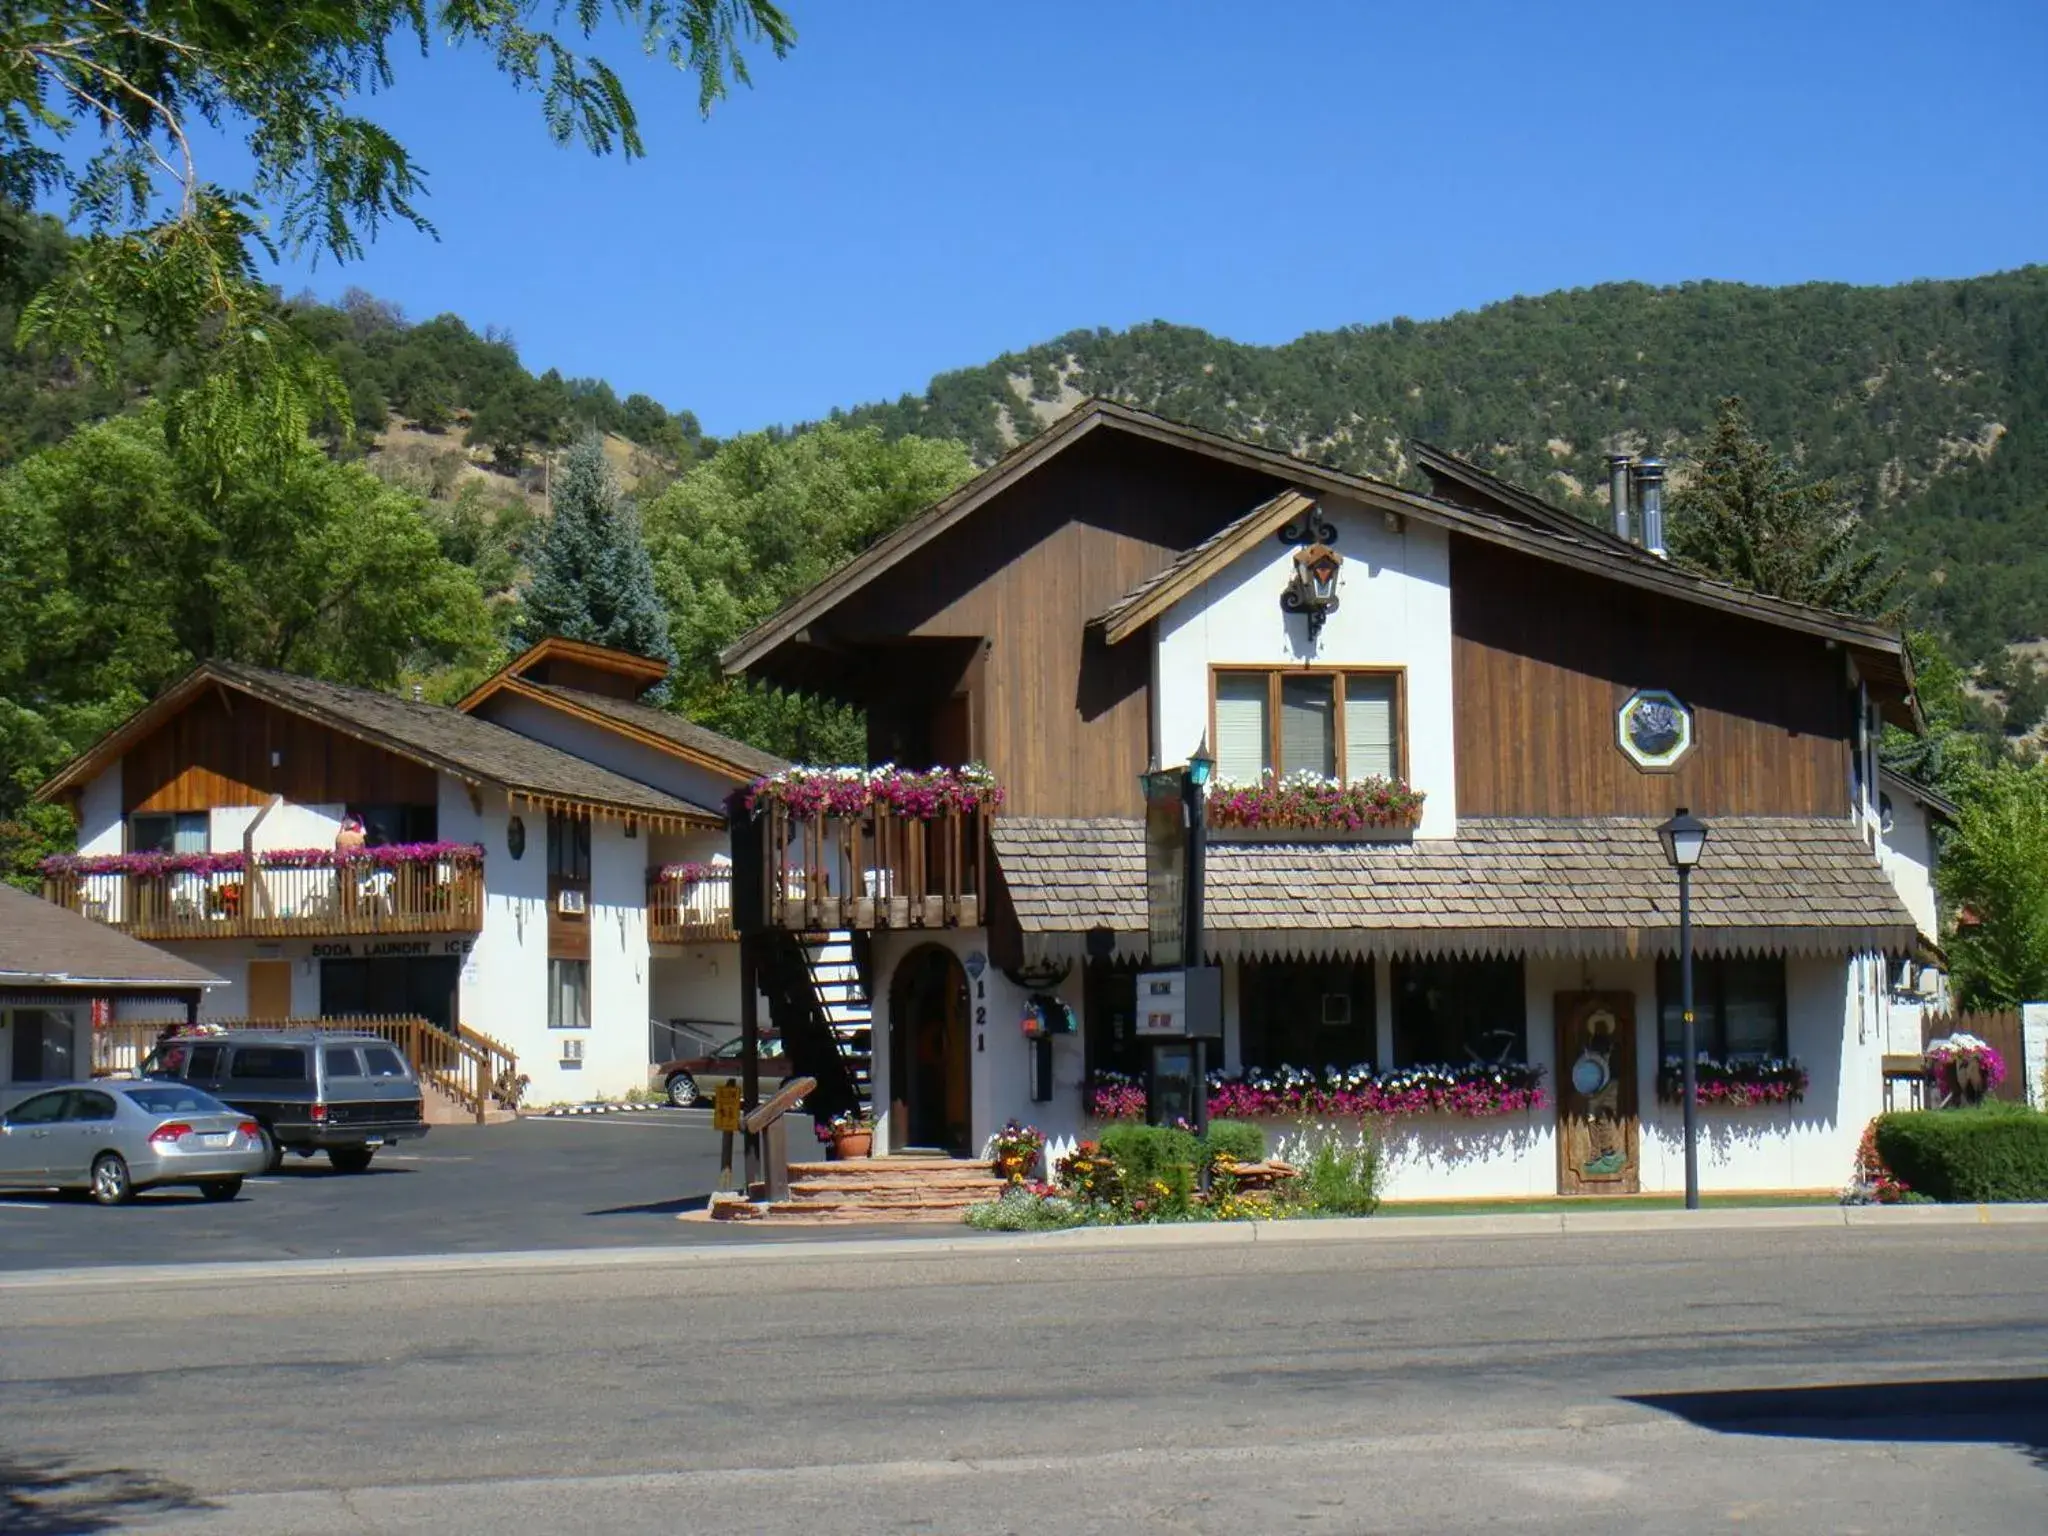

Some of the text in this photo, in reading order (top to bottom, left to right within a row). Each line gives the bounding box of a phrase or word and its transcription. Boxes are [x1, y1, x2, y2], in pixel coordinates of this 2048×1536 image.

[312, 939, 472, 957] SODA LAUNDRY ICE
[976, 980, 986, 1052] 121
